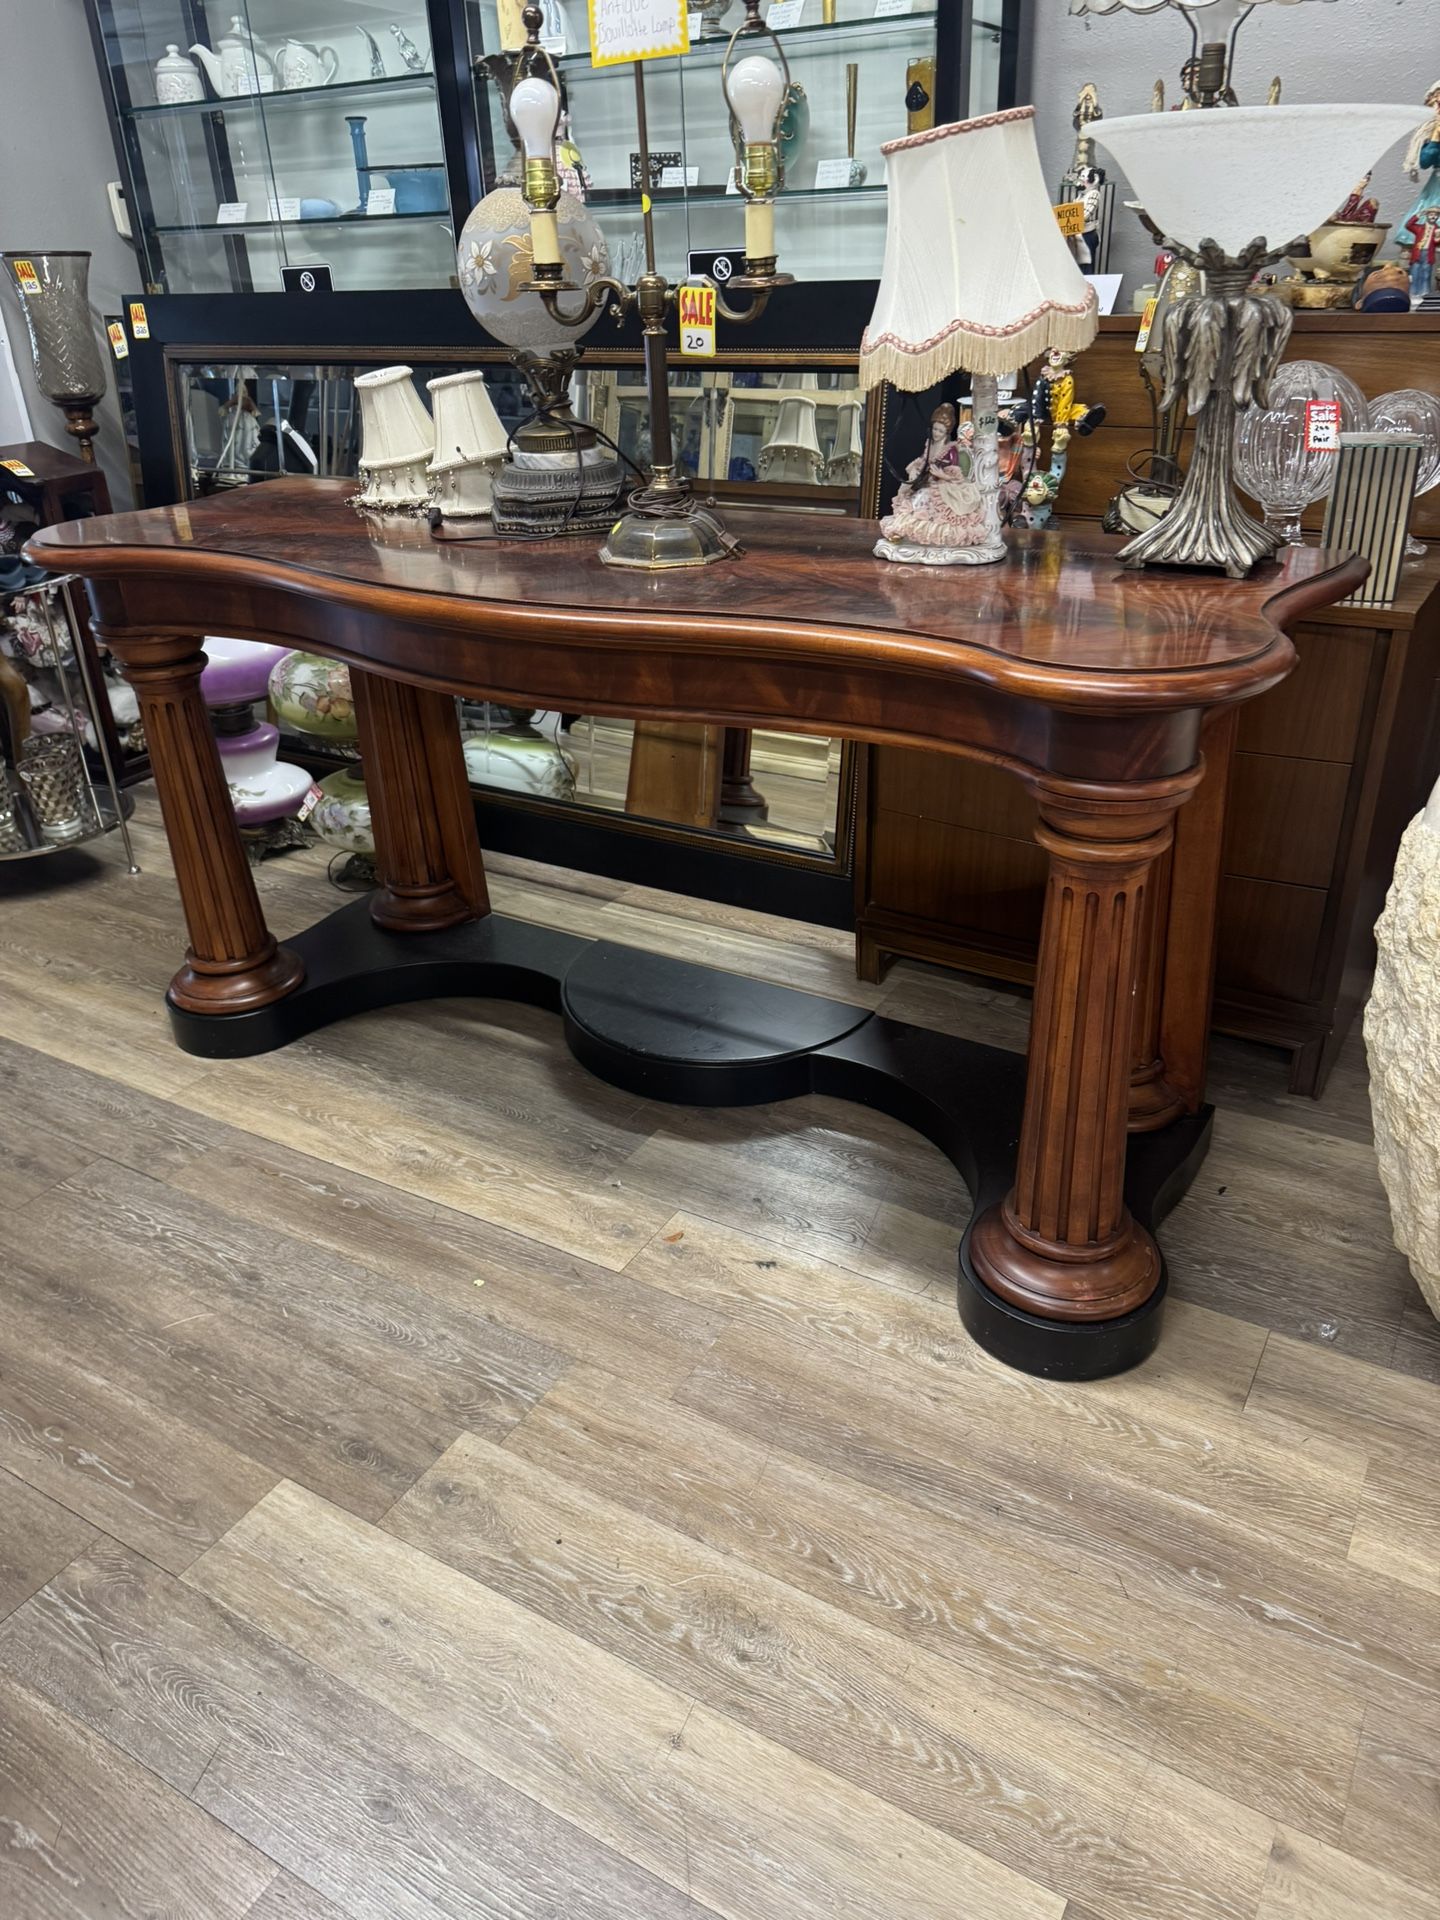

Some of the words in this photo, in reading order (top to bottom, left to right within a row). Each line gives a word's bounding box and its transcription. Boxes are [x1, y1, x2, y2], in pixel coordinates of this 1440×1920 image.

[15, 262, 36, 279] SALE
[131, 304, 146, 321] SALE
[681, 290, 713, 326] SALE
[686, 335, 704, 349] 20
[1310, 410, 1337, 421] Sale
[1312, 433, 1330, 443] Pair
